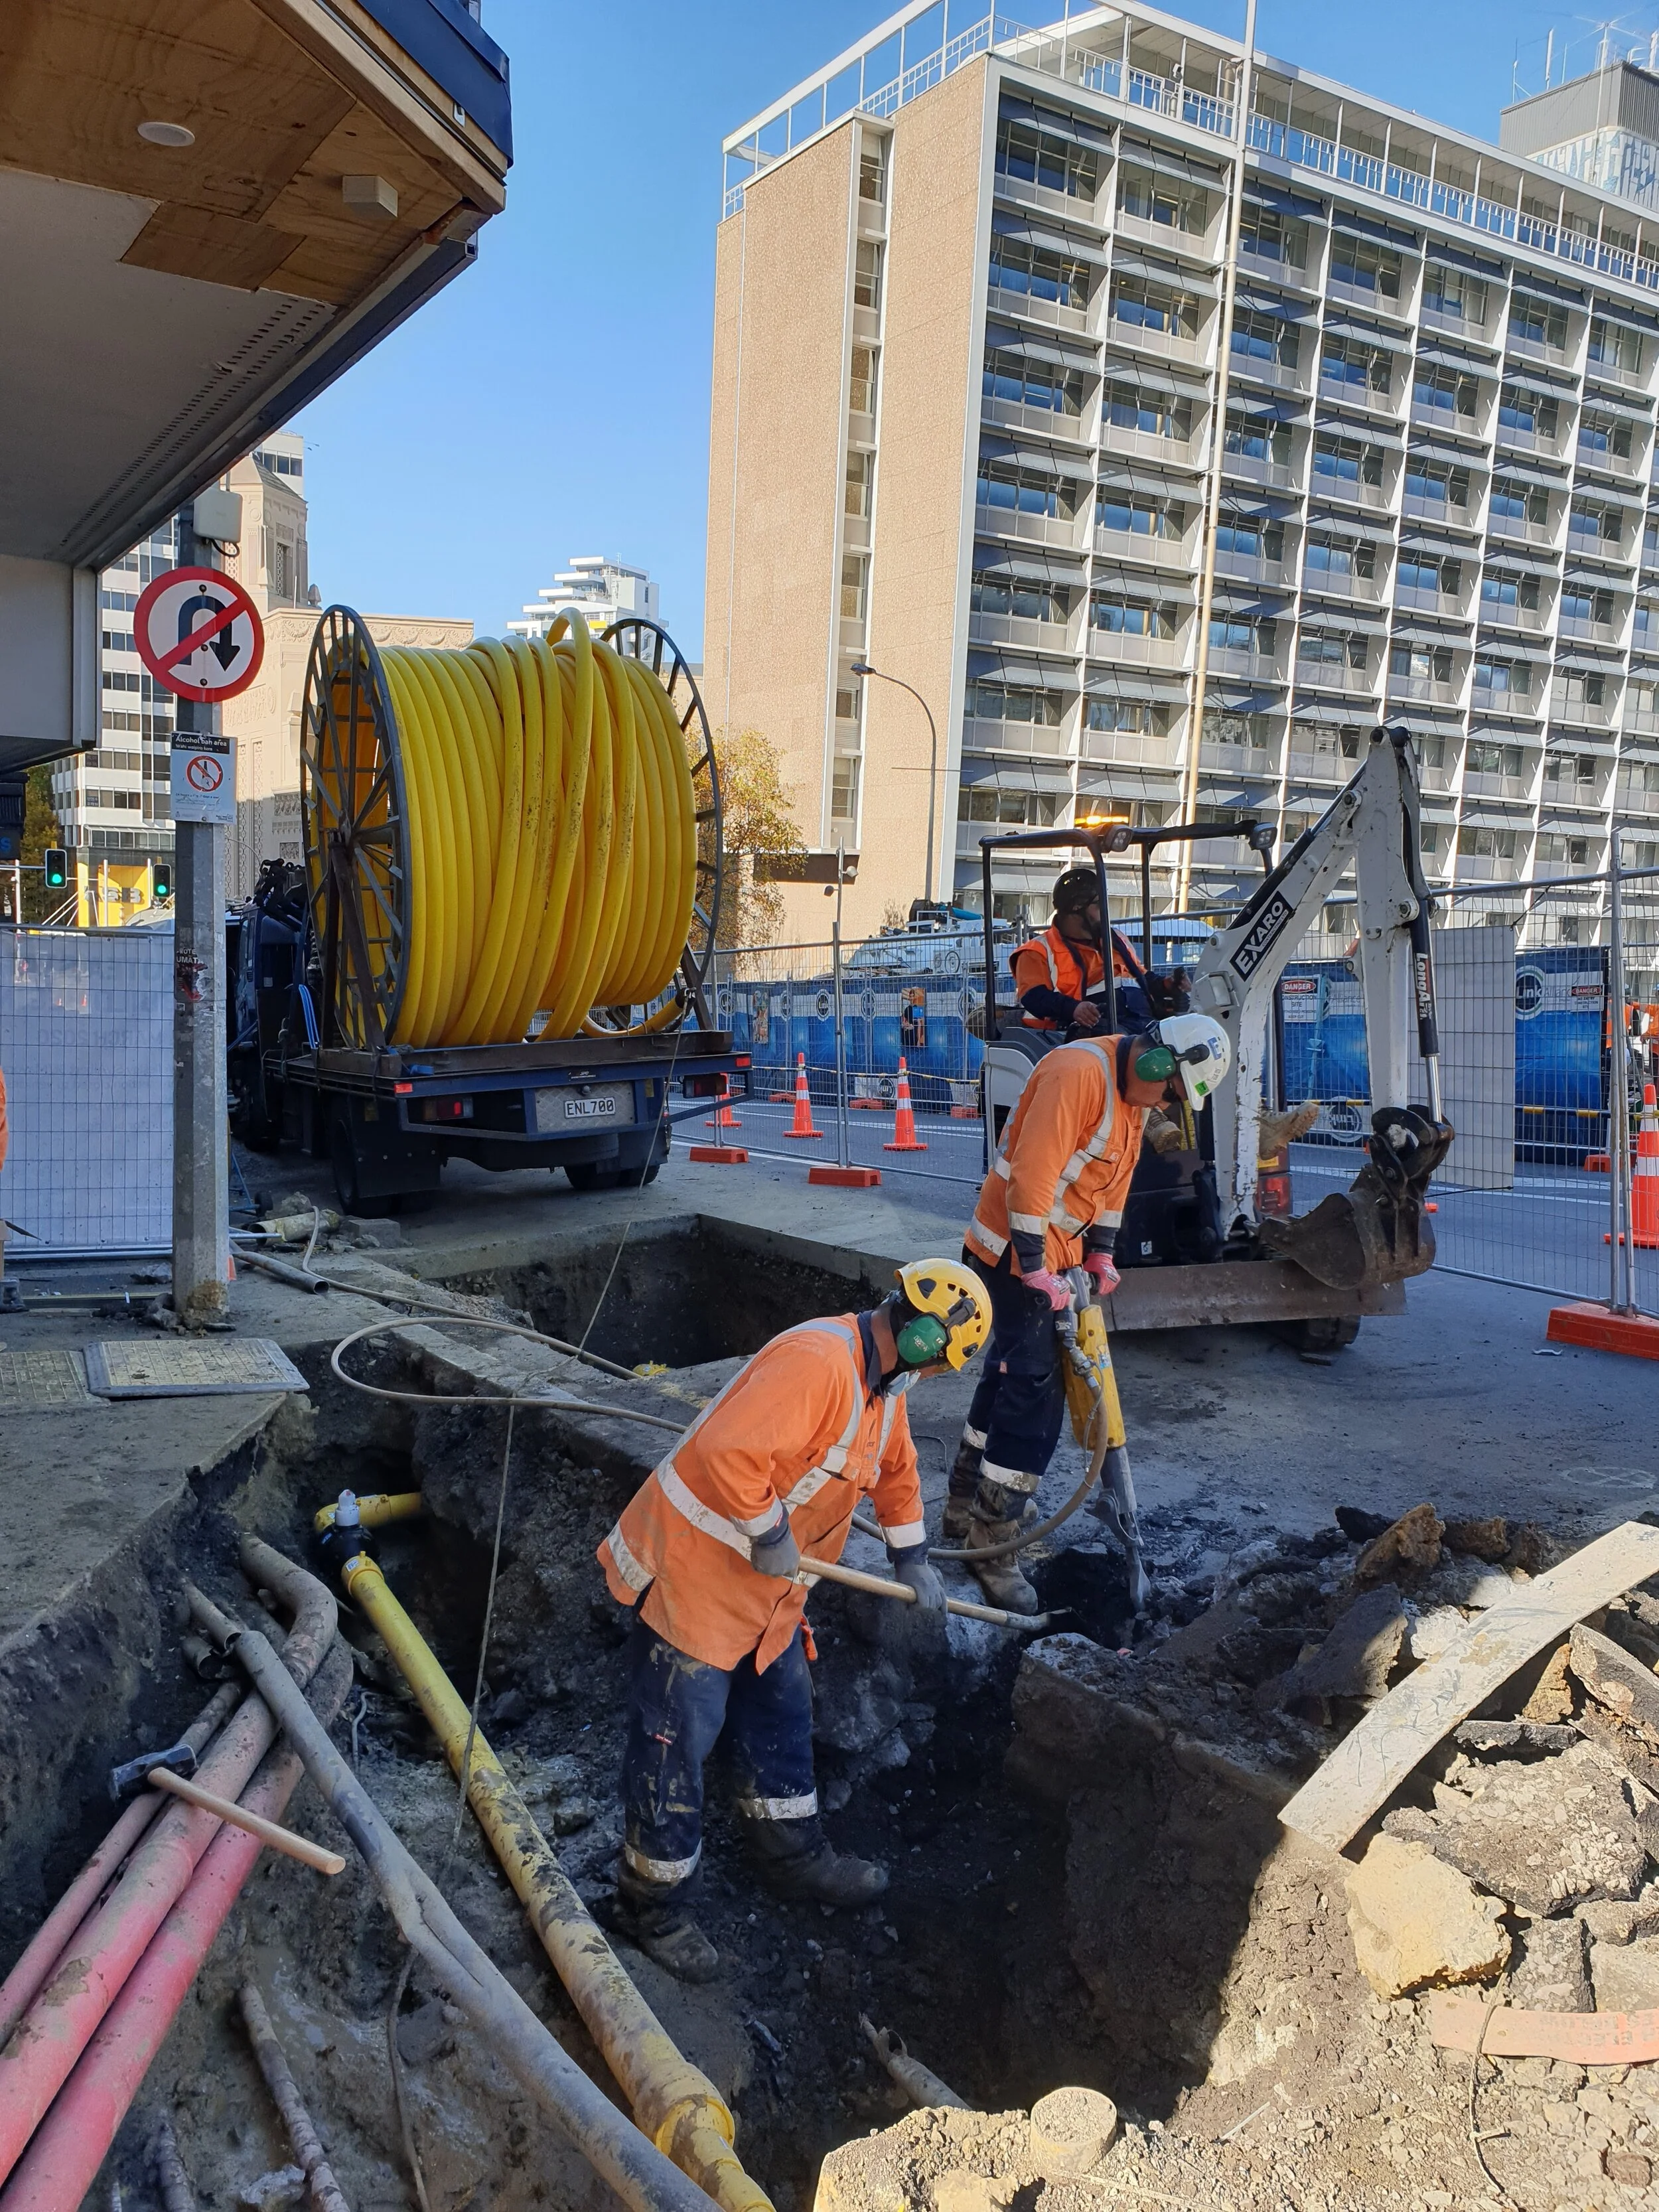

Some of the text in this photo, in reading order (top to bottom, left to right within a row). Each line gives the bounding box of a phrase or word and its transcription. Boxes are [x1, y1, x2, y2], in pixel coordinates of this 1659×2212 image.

[1234, 901, 1283, 975] EXARO
[1544, 987, 1571, 996] Allianc
[567, 1100, 614, 1116] ENL700
